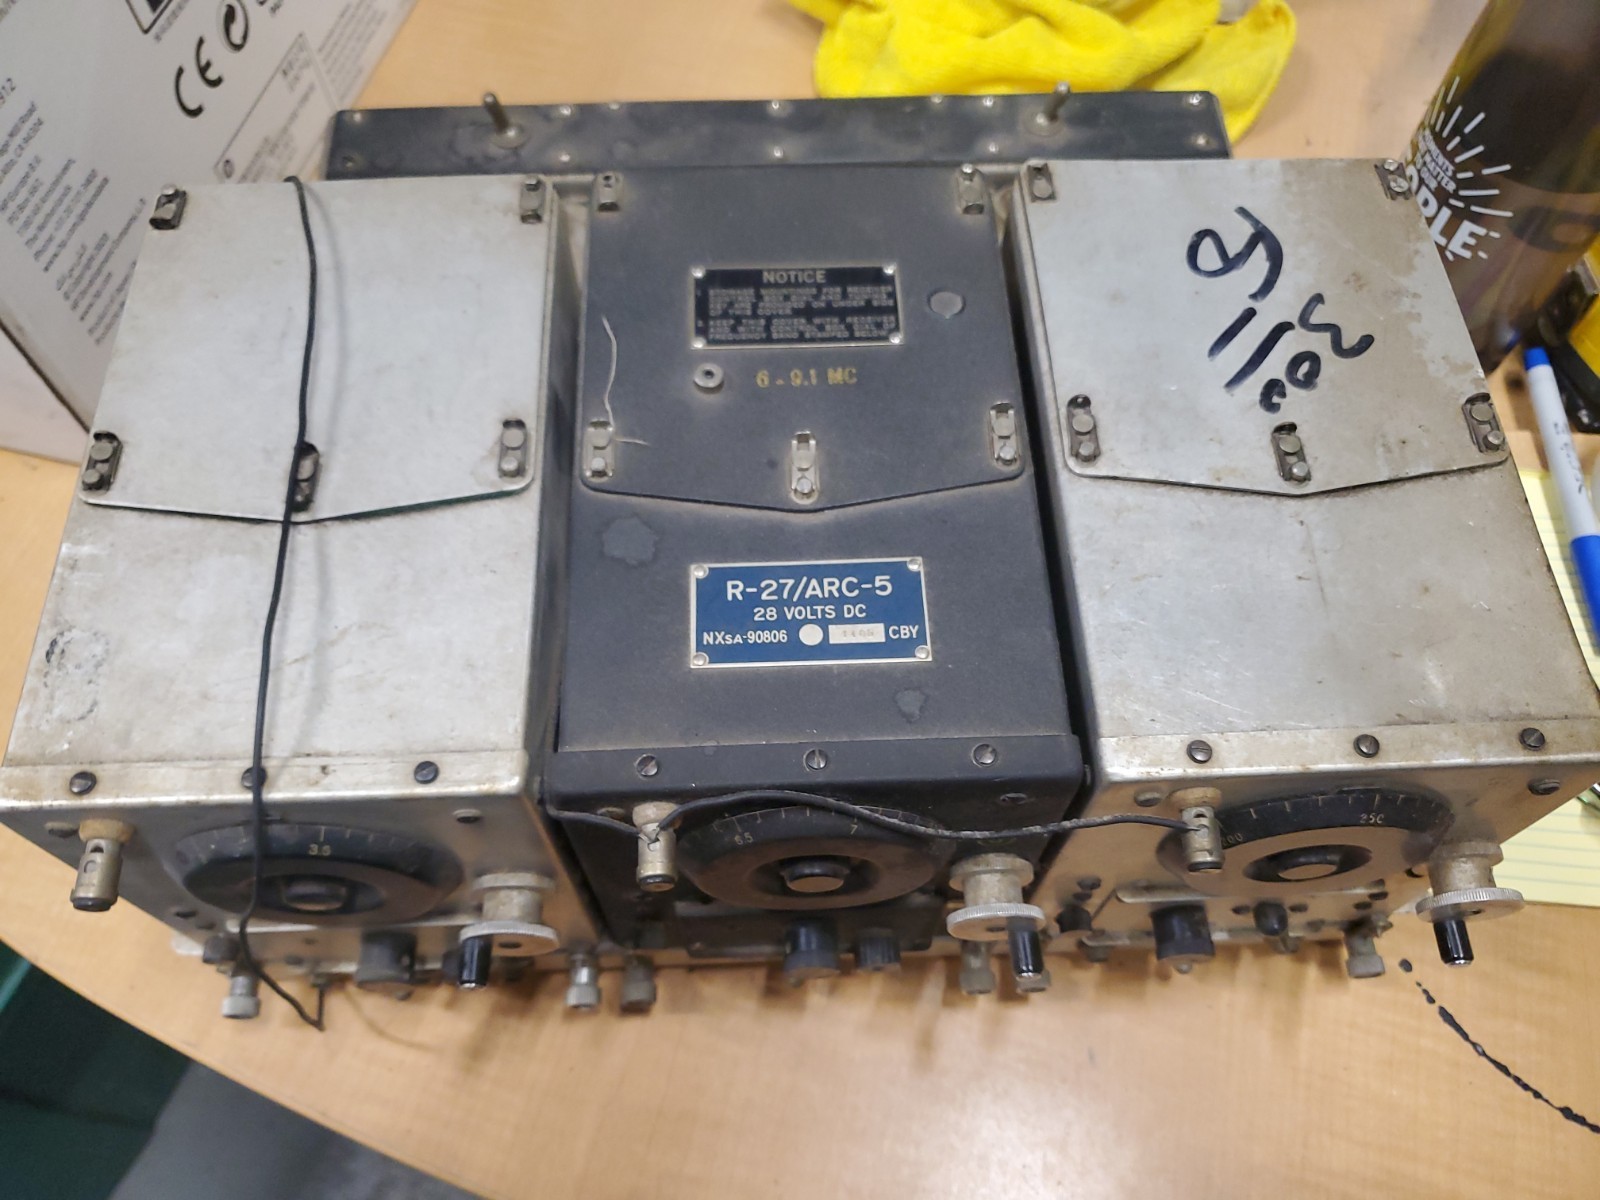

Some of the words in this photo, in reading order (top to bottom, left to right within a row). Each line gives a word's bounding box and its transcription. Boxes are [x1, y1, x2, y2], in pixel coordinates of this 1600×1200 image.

[762, 270, 827, 284] NOTICE
[755, 369, 770, 388] 6
[826, 367, 858, 385] MC
[726, 575, 893, 602] R-27/ARC-5
[753, 607, 778, 621] 28
[783, 605, 836, 620] VOLTS
[843, 604, 867, 618] DC
[888, 625, 920, 639] CBY
[850, 824, 859, 835] 7
